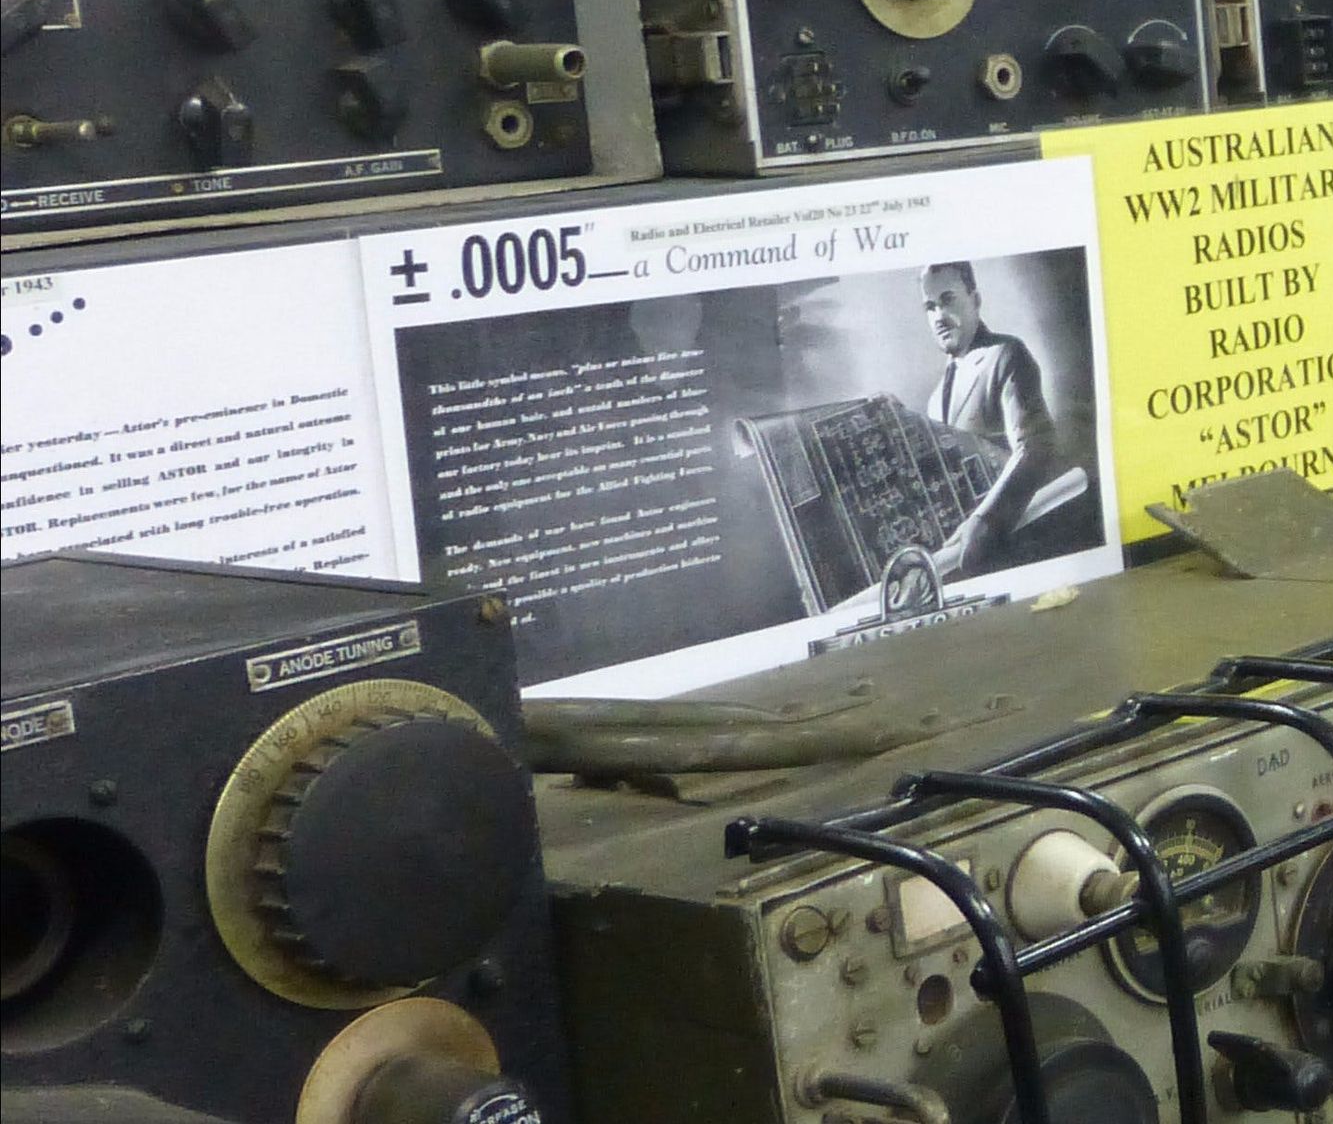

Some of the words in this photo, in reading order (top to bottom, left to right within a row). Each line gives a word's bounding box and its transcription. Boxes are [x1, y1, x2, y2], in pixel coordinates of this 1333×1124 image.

[825, 136, 854, 150] PLUG
[37, 190, 105, 208] RECEIVE
[194, 177, 232, 191] TONE
[630, 228, 664, 242] Radio
[668, 224, 690, 237] and
[694, 216, 745, 234] Electrical
[748, 212, 790, 228] Retailer
[907, 195, 931, 209] 1943
[1124, 187, 1201, 223] WW2
[666, 234, 797, 274] Command
[815, 229, 837, 262] of
[854, 224, 909, 253] War
[1193, 220, 1305, 265] RADIOS
[14, 277, 53, 294] 1943
[1184, 271, 1274, 315] BUILT
[1283, 263, 1320, 296] BY
[1209, 314, 1305, 359] RADIO
[27, 431, 100, 452] yesterday
[175, 403, 268, 426] pre-eminence
[290, 387, 349, 405] Domestic
[110, 452, 122, 464] It
[127, 449, 154, 460] was
[170, 439, 212, 454] direct
[216, 433, 241, 445] and
[245, 423, 296, 440] natural
[79, 484, 94, 497] in
[102, 475, 149, 495] selling
[157, 464, 207, 483] ASTOR
[215, 458, 240, 472] and
[277, 440, 334, 463] integrity
[47, 504, 151, 530] Replacements
[153, 495, 189, 511] were
[222, 483, 243, 499] for
[246, 478, 267, 493] the
[270, 472, 305, 487] name
[307, 467, 321, 480] of
[324, 460, 358, 478] Astor
[139, 524, 170, 540] with
[175, 517, 205, 534] long
[208, 500, 291, 526] trouble-free
[282, 540, 297, 552] of
[312, 525, 366, 547] satisfied
[313, 550, 370, 573] Replace-
[279, 647, 335, 677] ANODE
[336, 636, 393, 663] TUNING
